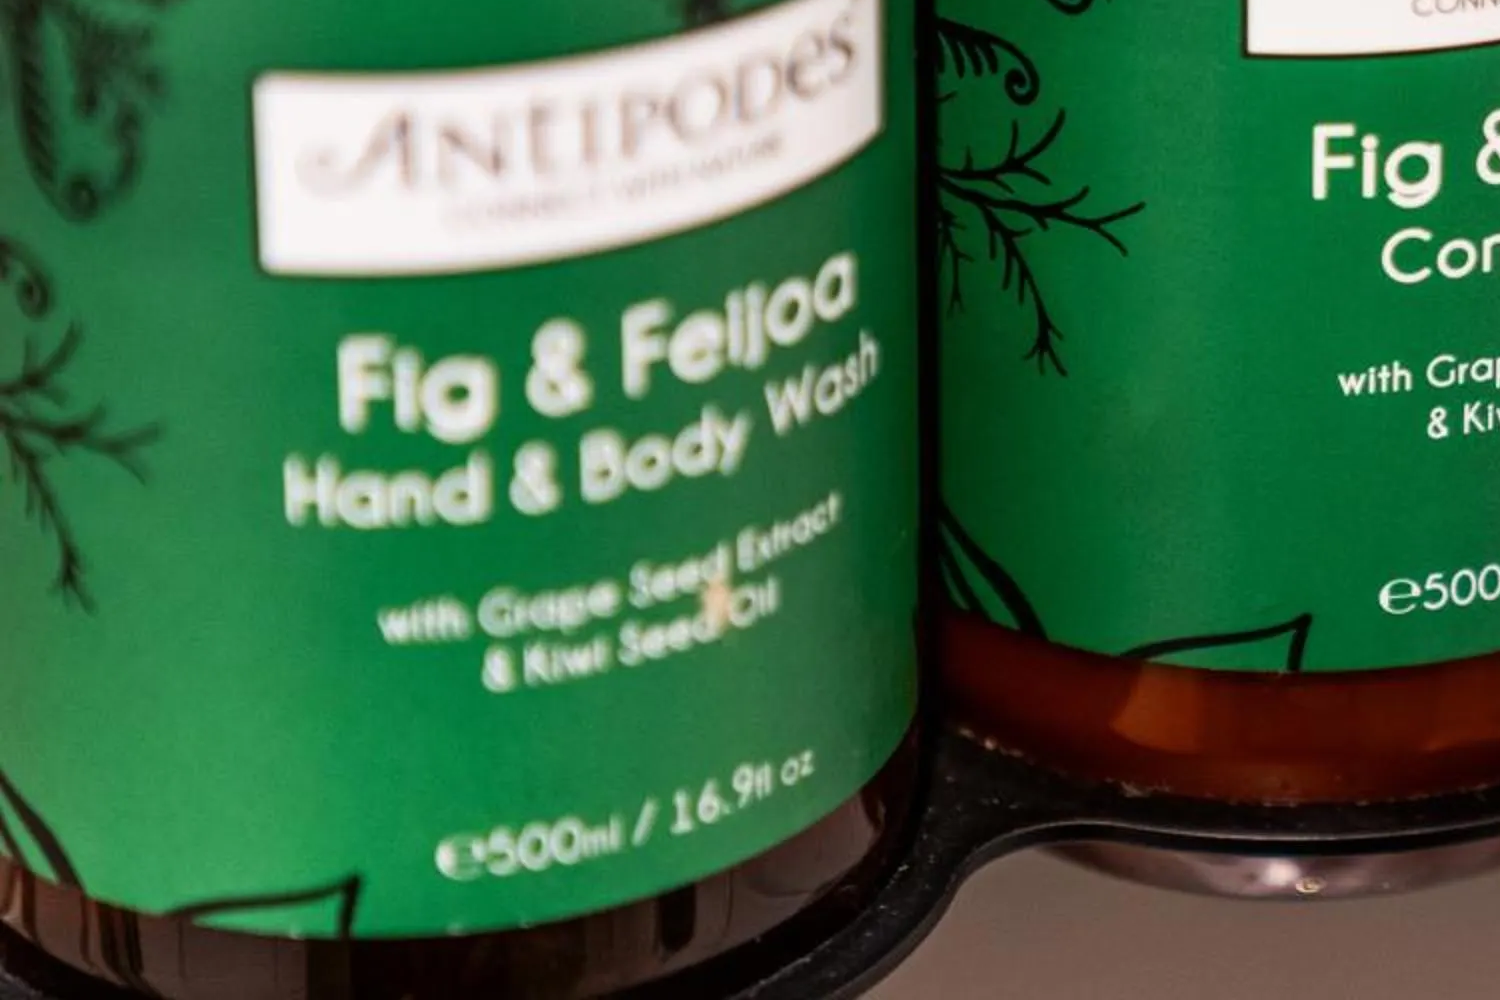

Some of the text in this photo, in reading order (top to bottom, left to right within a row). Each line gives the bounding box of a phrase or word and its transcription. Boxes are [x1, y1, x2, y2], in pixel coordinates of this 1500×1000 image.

[1311, 122, 1443, 209] Fig
[337, 251, 858, 444] Fig & Feijoa
[1337, 361, 1413, 397] with
[282, 328, 881, 530] Hand & Body Wash
[1426, 406, 1449, 440] &
[378, 491, 842, 645] with Grape Seed Extract
[481, 645, 516, 693] &
[522, 636, 613, 687] Kiwi
[728, 576, 780, 628] Oil
[631, 799, 660, 846] /
[780, 748, 815, 786] oz
